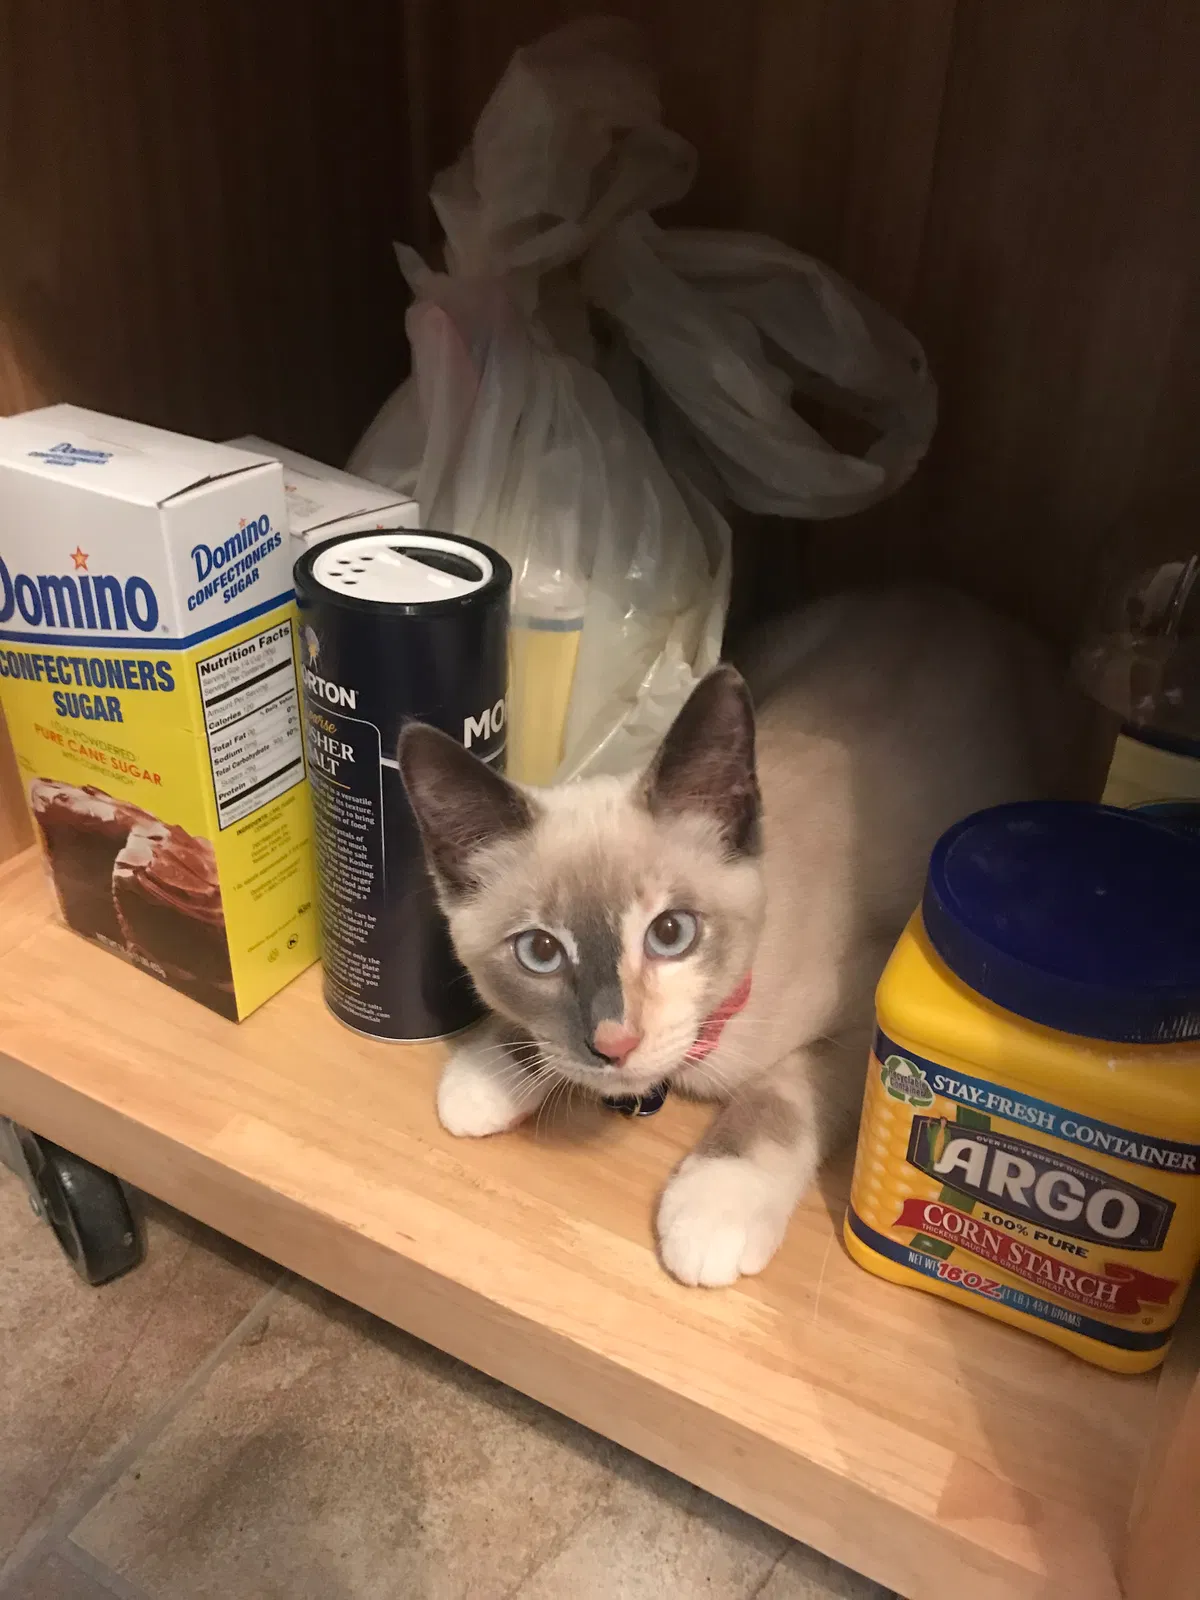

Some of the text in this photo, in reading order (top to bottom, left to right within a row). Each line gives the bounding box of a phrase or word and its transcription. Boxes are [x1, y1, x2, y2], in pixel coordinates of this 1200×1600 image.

[191, 514, 269, 582] Domino
[187, 532, 282, 611] CONFECTIONERS
[223, 567, 260, 604] SUGAR
[200, 627, 290, 676] Nutrition Facts
[0, 650, 175, 692] CONFECTIONERS
[53, 691, 124, 723] SUGAR
[209, 711, 242, 730] Calories
[212, 740, 232, 754] Total
[234, 732, 247, 744] Fat
[34, 723, 162, 786] PURE CANE SUGAR
[214, 747, 243, 766] Sodium
[215, 764, 231, 777] Total
[232, 744, 270, 768] Carbohydrate
[218, 781, 246, 800] Protein
[341, 792, 373, 806] versatile
[355, 813, 375, 825] bring
[348, 842, 368, 852] much
[354, 852, 368, 860] salt
[349, 857, 374, 869] Kosher
[351, 874, 372, 885] larger
[357, 883, 371, 893] and
[354, 911, 366, 919] can
[364, 921, 376, 930] for
[362, 963, 380, 973] plate
[368, 957, 381, 965] the
[365, 979, 378, 987] you
[933, 1074, 1197, 1171] STAY-FRESH CONTAINER
[976, 1135, 1000, 1147] OVER
[1003, 1143, 1019, 1152] 100
[1021, 1147, 1052, 1164] YEARS
[933, 1138, 1141, 1239] ARGO
[982, 1211, 1090, 1259] 100% PURE
[922, 1223, 960, 1243] THICKENS
[960, 1238, 991, 1259] SAUCES
[1036, 1276, 1063, 1293] GREAT
[1064, 1288, 1080, 1301] FOR
[923, 1204, 1122, 1303] CORN STARCH
[908, 1252, 923, 1266] NET
[1032, 1299, 1049, 1317] 454
[1050, 1308, 1083, 1328] GRAMS
